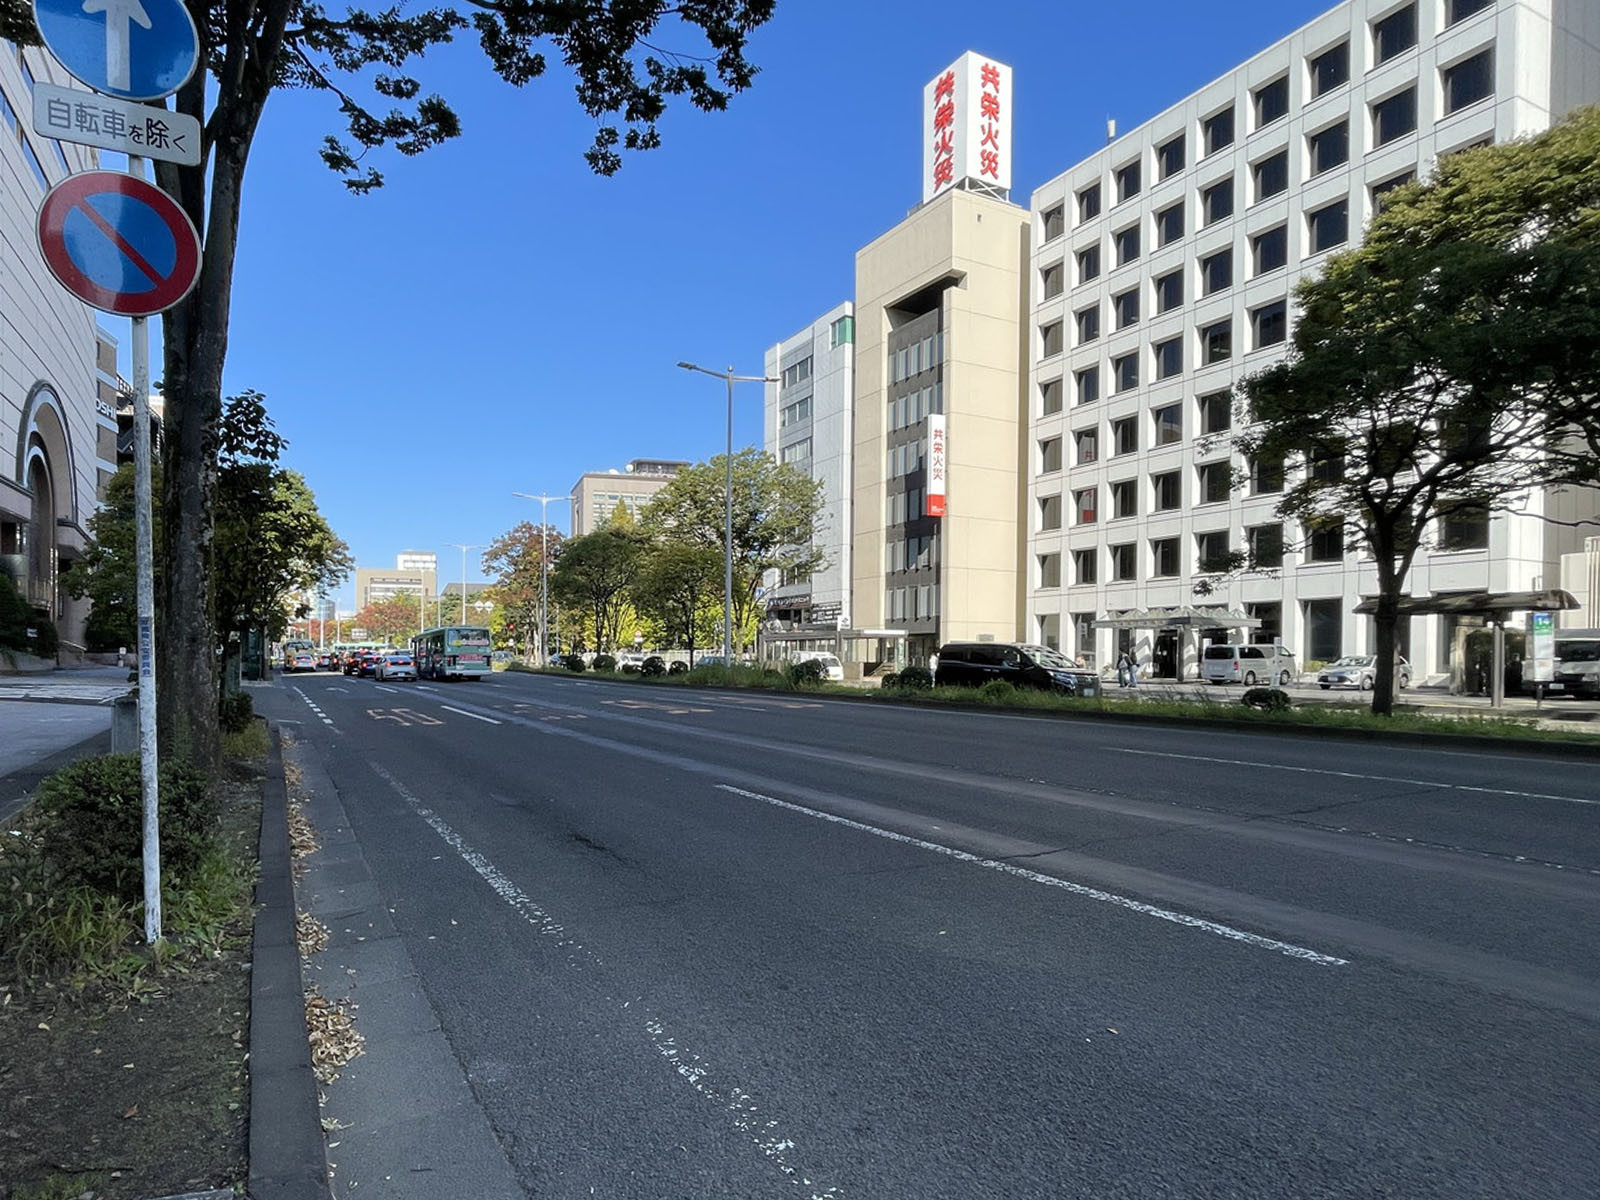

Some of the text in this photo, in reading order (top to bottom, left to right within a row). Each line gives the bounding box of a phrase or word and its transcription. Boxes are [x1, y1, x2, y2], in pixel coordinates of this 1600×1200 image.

[47, 98, 187, 154] 自転車を除く
[933, 70, 955, 194] 共栄火災
[980, 62, 1000, 180] 共栄火災
[932, 428, 944, 481] 共栄火災
